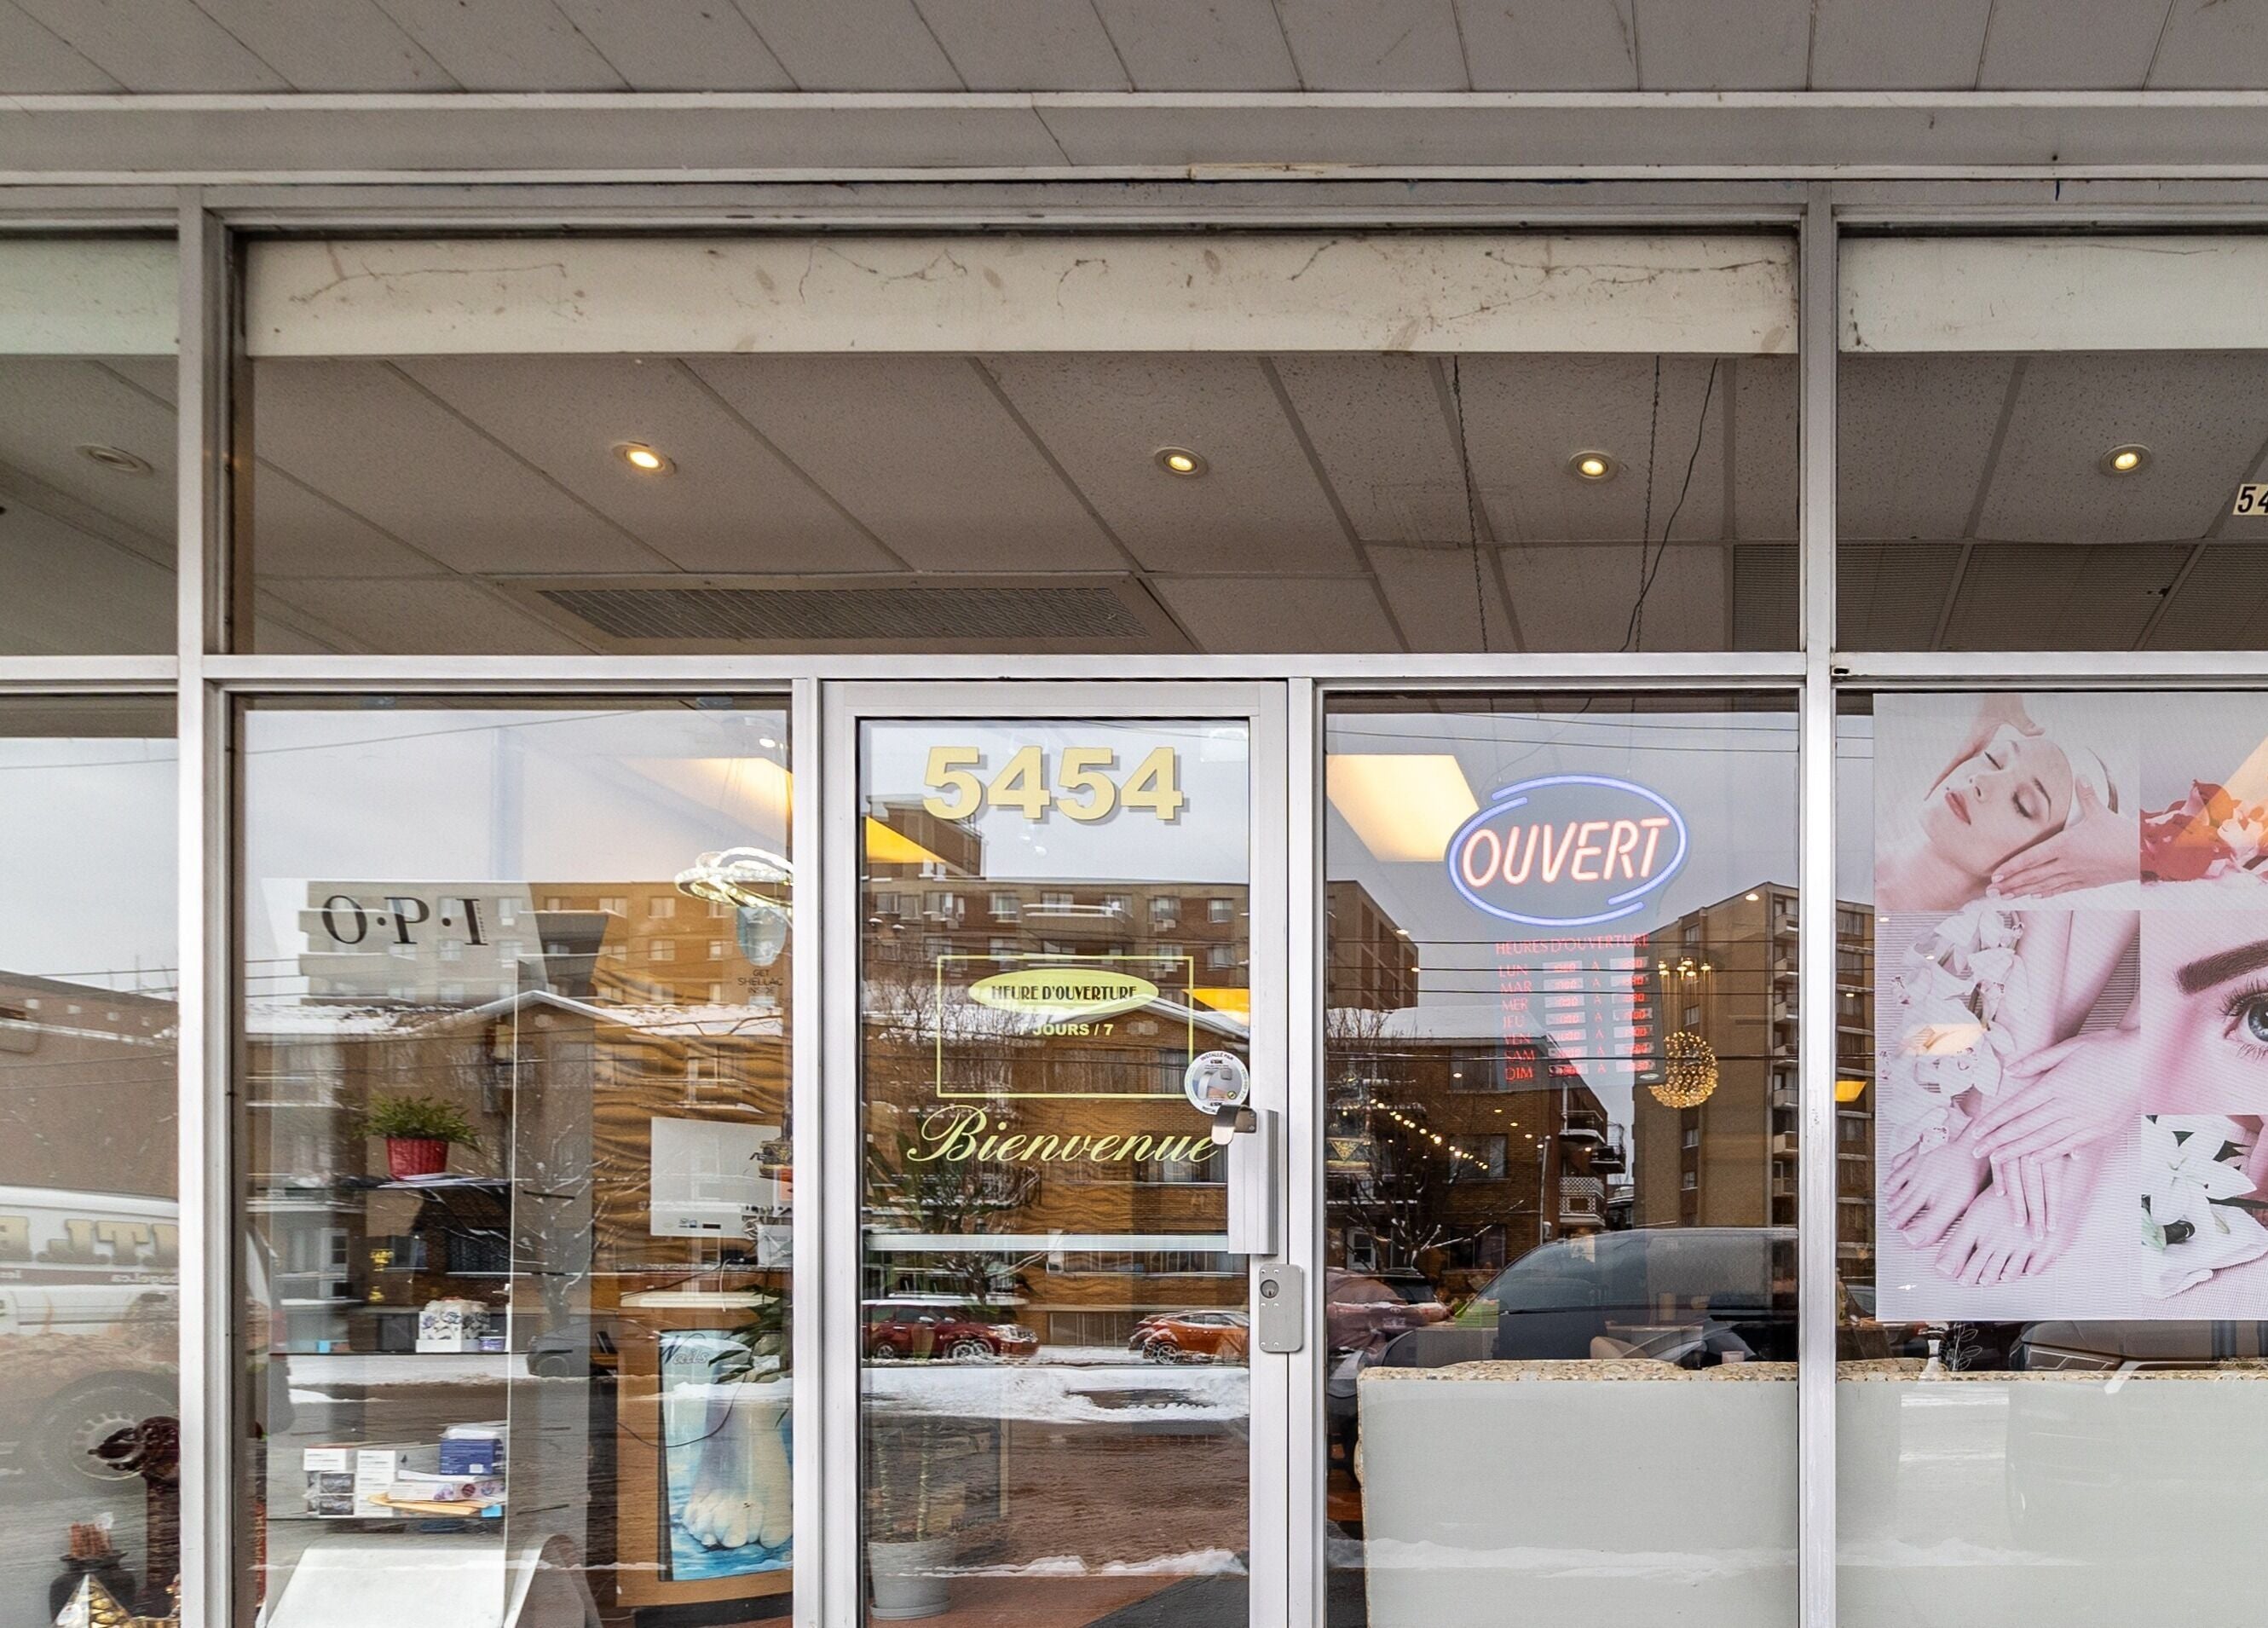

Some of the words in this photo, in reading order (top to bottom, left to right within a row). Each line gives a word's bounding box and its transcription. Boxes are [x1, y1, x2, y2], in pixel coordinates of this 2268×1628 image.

[922, 746, 1186, 824] 5454
[1462, 816, 1670, 889] OUVERT
[1496, 939, 1548, 955] HEURES
[1498, 963, 1528, 978] LUN
[737, 978, 784, 986] SHELLAC
[1500, 980, 1532, 993] MAR
[991, 985, 1039, 1001] HEURE
[1042, 985, 1138, 1001] D'OUVERTURE
[1502, 998, 1528, 1011] MER
[1033, 1023, 1090, 1036] JOURS
[1104, 1023, 1114, 1036] 7
[1503, 1016, 1524, 1029] JEU
[1504, 1050, 1536, 1063] SAM
[1504, 1067, 1534, 1083] DIM
[907, 1104, 1219, 1163] Bienvenue
